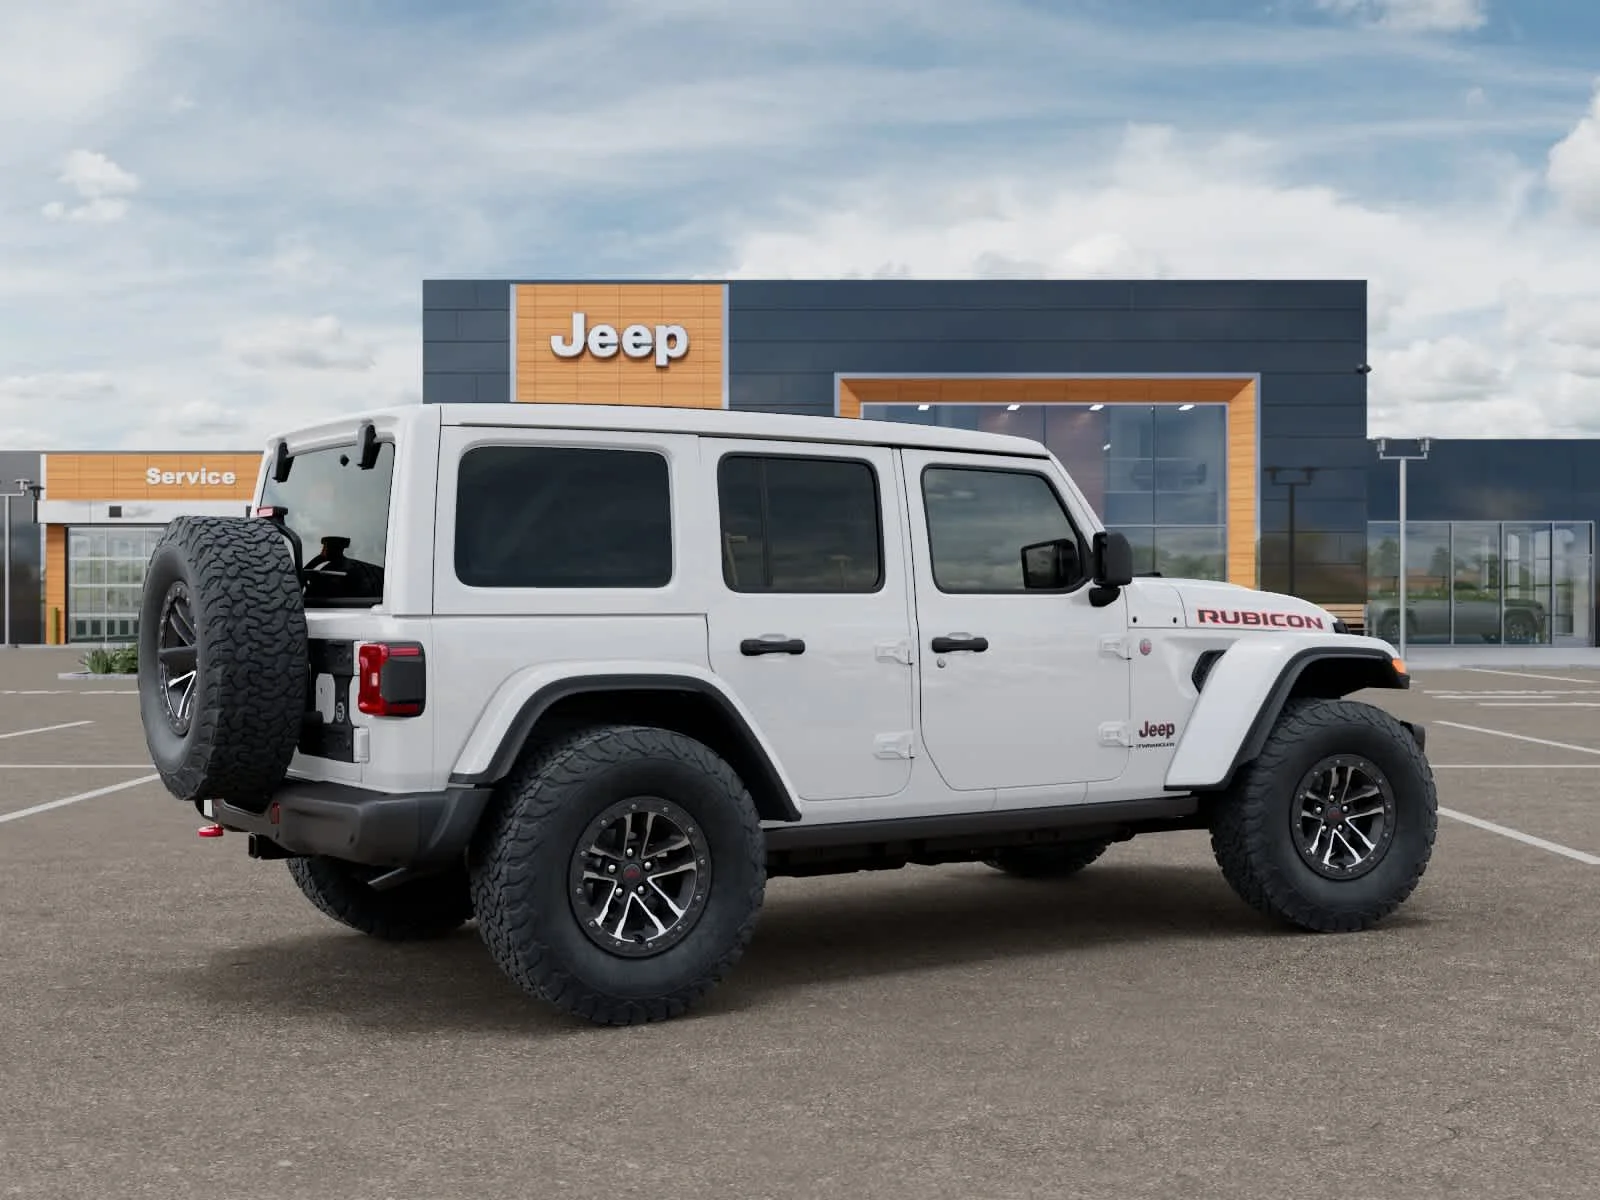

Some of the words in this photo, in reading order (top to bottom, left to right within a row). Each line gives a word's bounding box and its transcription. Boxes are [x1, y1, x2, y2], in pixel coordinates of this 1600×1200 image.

[550, 312, 689, 367] Jeep
[146, 467, 236, 486] Service
[1197, 609, 1324, 630] RUBICON
[1138, 720, 1175, 739] Jeep
